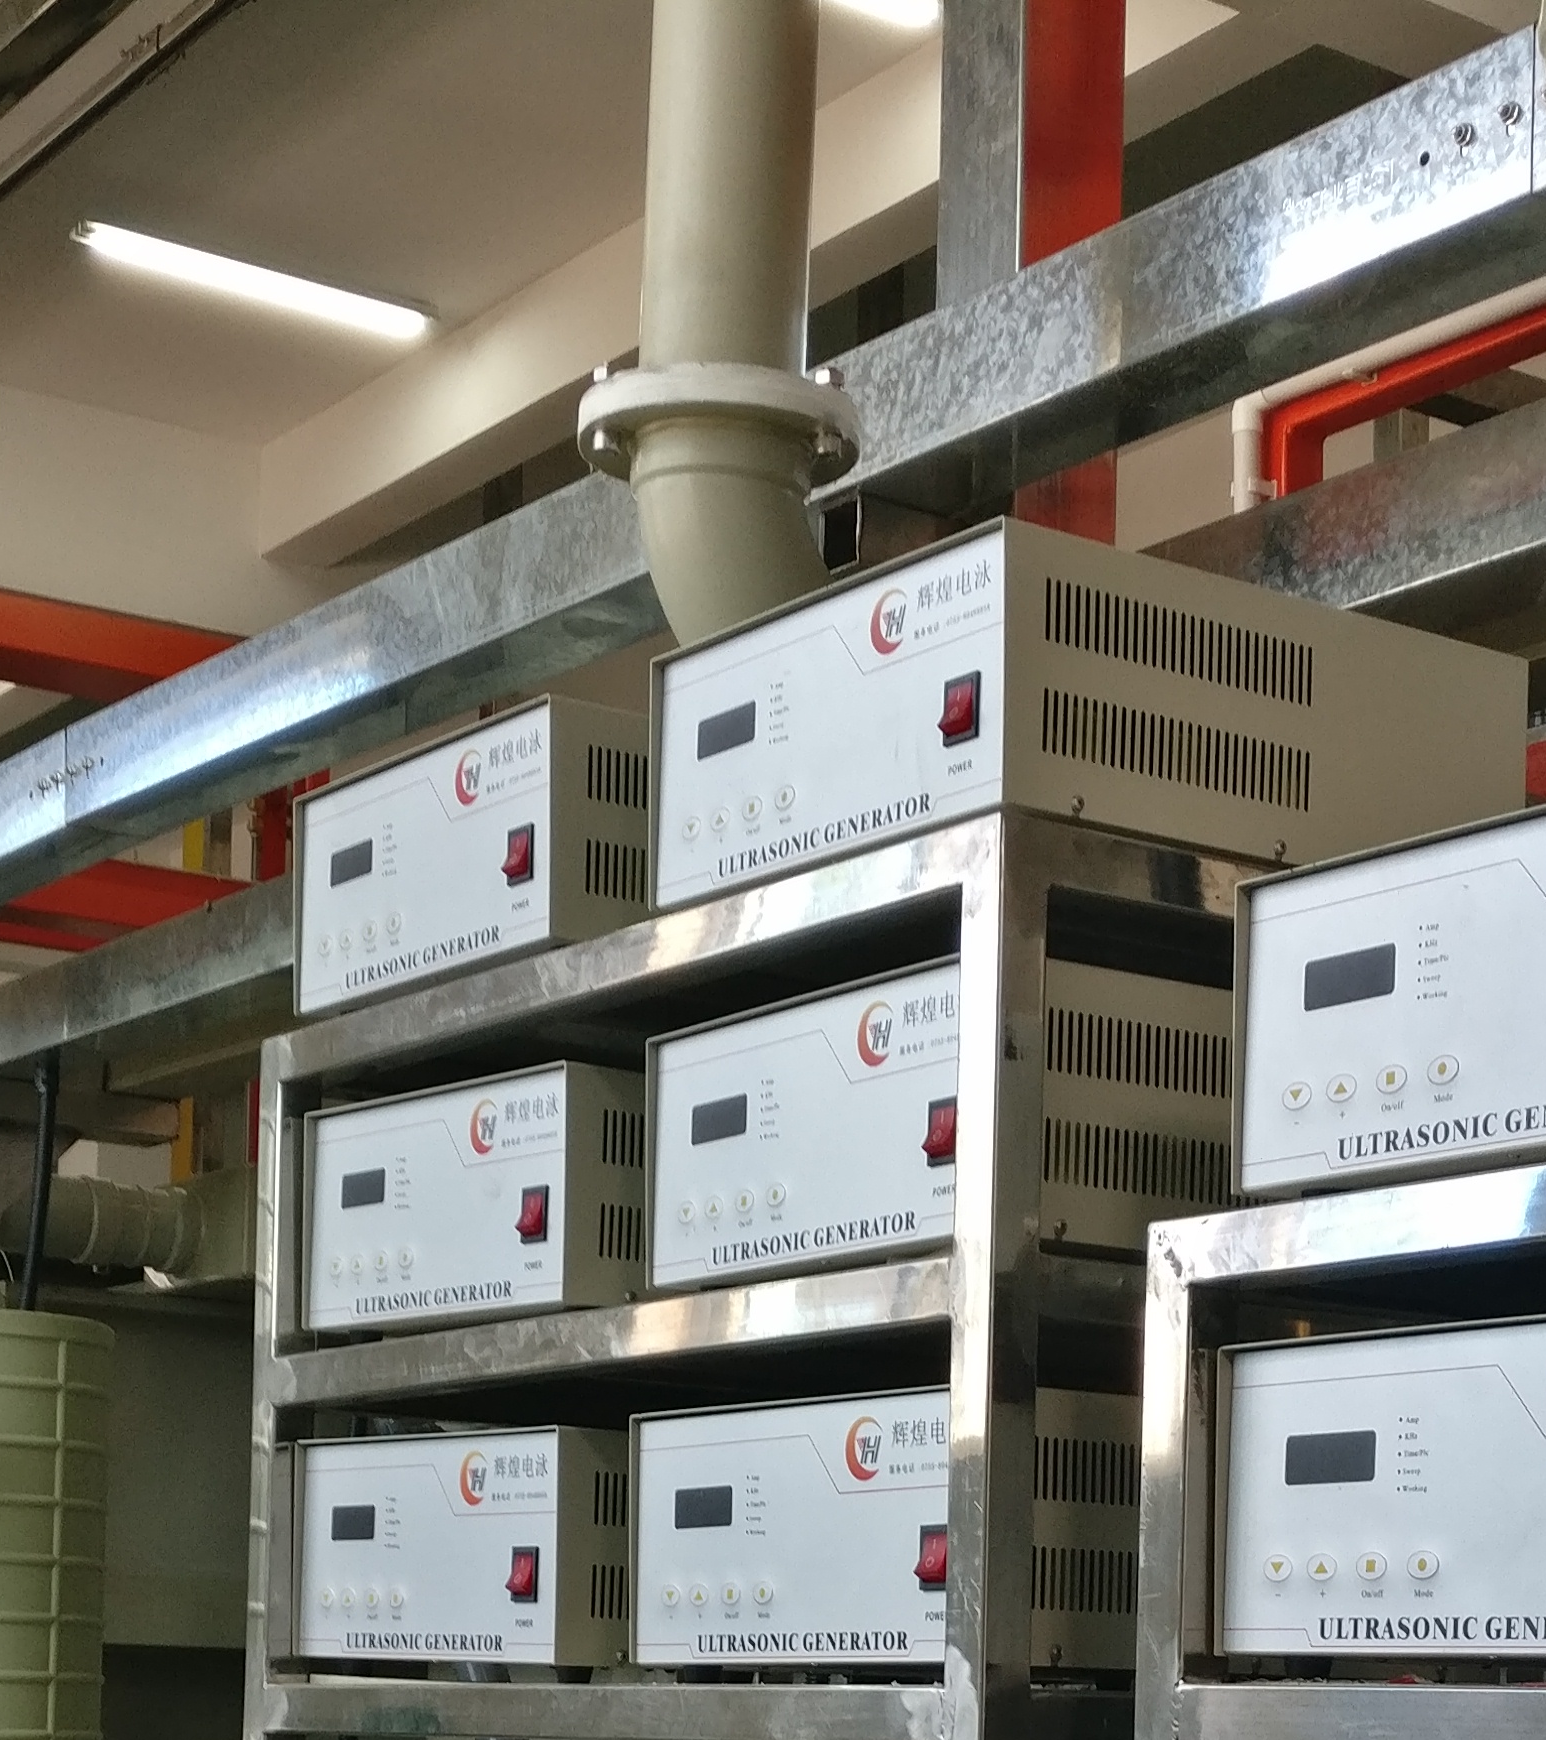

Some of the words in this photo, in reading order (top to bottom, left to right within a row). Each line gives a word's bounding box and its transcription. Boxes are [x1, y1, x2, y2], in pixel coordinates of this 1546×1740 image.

[916, 558, 991, 612] 辉煌电泳
[948, 759, 972, 775] POWER
[718, 827, 819, 878] ULTRASONIC
[824, 791, 930, 844] GENERATOR
[345, 949, 419, 989] ULTRASONIC
[423, 924, 499, 965] GENERATOR
[902, 983, 957, 1028] 辉煌电
[1338, 1111, 1496, 1160] ULTRASONIC
[712, 1229, 808, 1265] ULTRASONIC
[814, 1210, 915, 1247] GENERATOR
[356, 1289, 430, 1314] ULTRASONIC
[435, 1280, 511, 1306] GENERATOR
[891, 1414, 948, 1448] 辉煌电
[925, 1611, 948, 1620] POWE
[1319, 1615, 1476, 1640] ULTRASONIC
[346, 1633, 421, 1649] ULTRASONIC
[425, 1634, 502, 1650] GENERATOR
[697, 1632, 797, 1652] ULTRASONIC
[803, 1631, 908, 1651] GENERATOR
